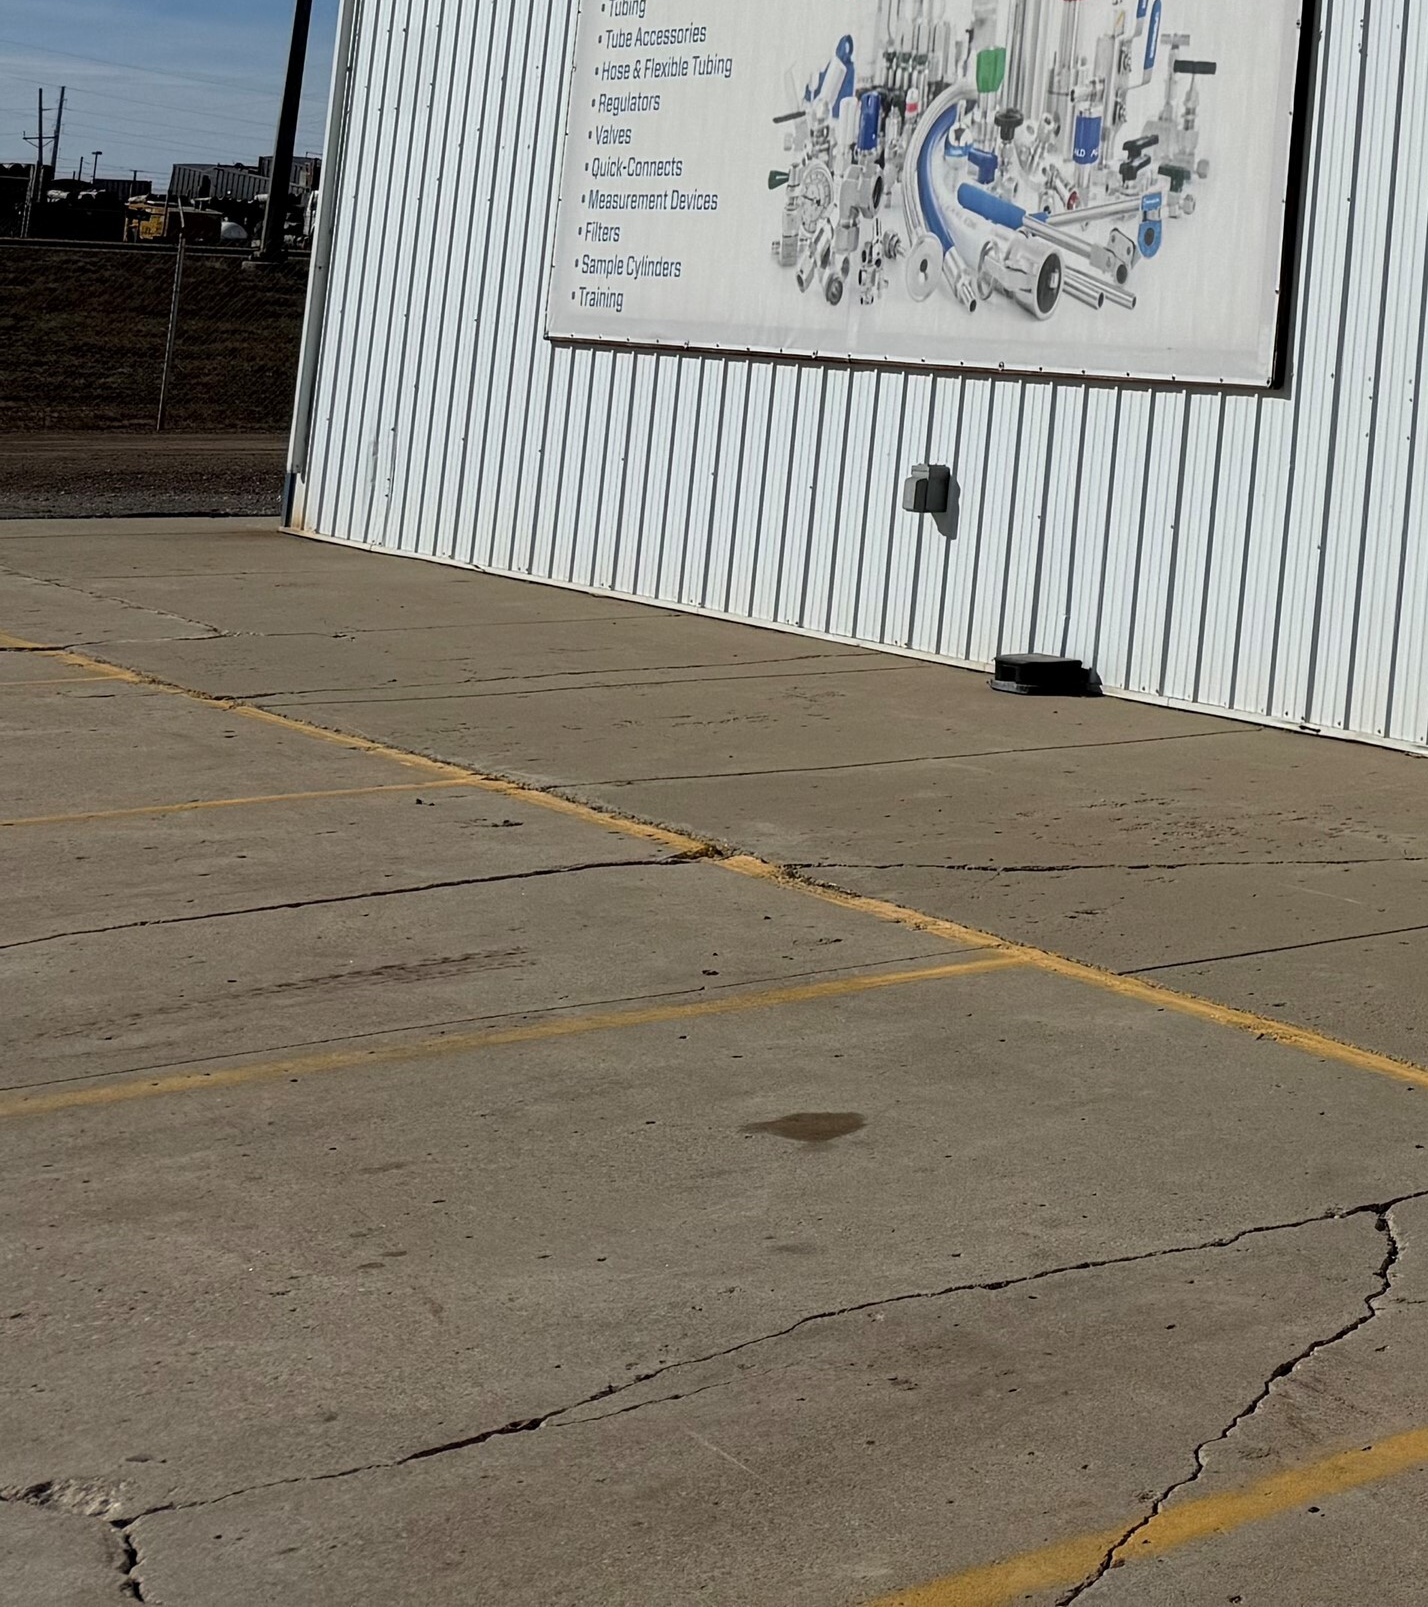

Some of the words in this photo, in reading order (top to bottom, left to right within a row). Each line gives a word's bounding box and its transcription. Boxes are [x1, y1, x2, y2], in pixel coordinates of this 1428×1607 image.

[605, 29, 632, 49] Tube
[634, 22, 707, 47] Accessories
[601, 61, 631, 81] Hose
[633, 60, 641, 79] &
[643, 56, 689, 79] Flexible
[692, 54, 733, 78] Tubing
[598, 93, 660, 116] Regulators
[595, 124, 632, 145] Valves
[591, 157, 683, 179] Quick-Connects
[587, 189, 668, 210] Measurement
[670, 188, 718, 211] Devices
[584, 222, 620, 242] Filters
[581, 254, 624, 279] Sample
[626, 255, 682, 280] Cylinders
[579, 286, 624, 312] Training
